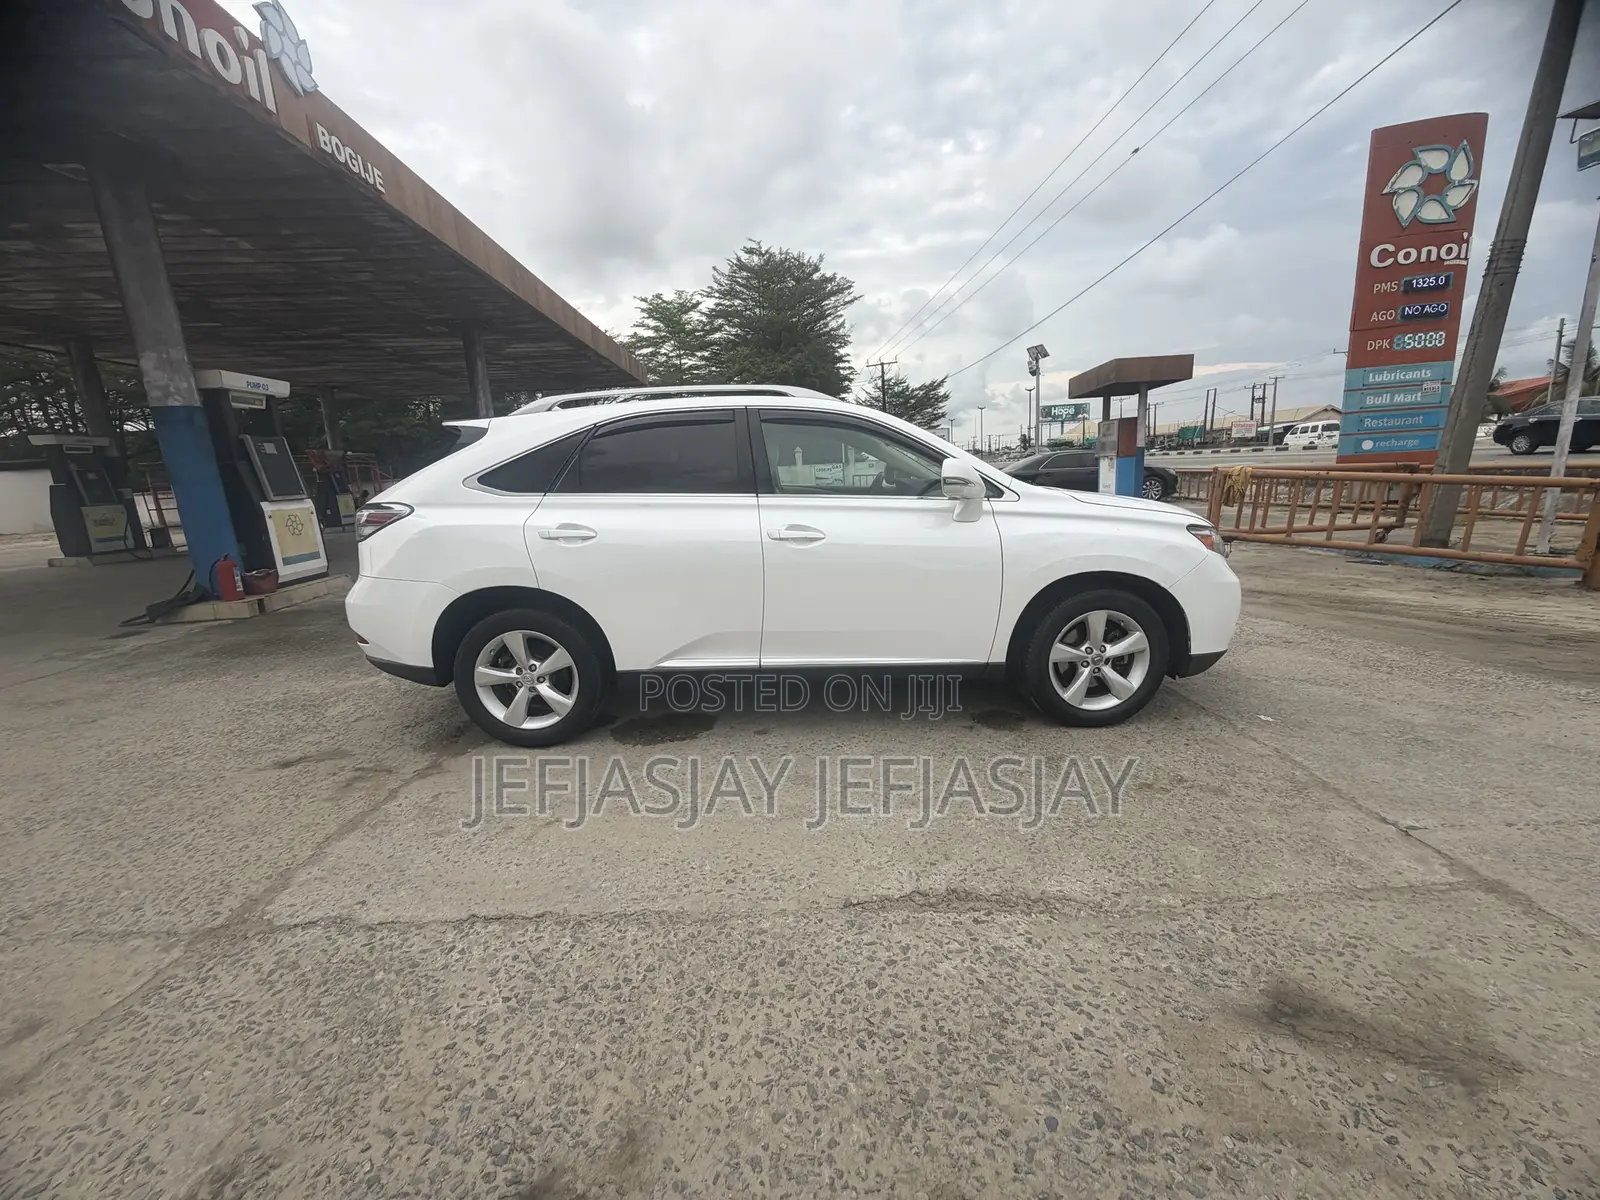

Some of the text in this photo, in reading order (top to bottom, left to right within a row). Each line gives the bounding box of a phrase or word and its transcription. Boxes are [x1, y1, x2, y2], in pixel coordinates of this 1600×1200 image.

[316, 122, 386, 194] BOGIJE
[1373, 275, 1446, 294] PMS 1325.0
[1370, 303, 1448, 322] AGO NO AGO
[1367, 338, 1391, 351] DPK
[1368, 368, 1432, 382] Lubricants
[1366, 391, 1422, 405] Bull Mart
[1364, 415, 1424, 428] Restaurant
[1375, 438, 1420, 449] recharge
